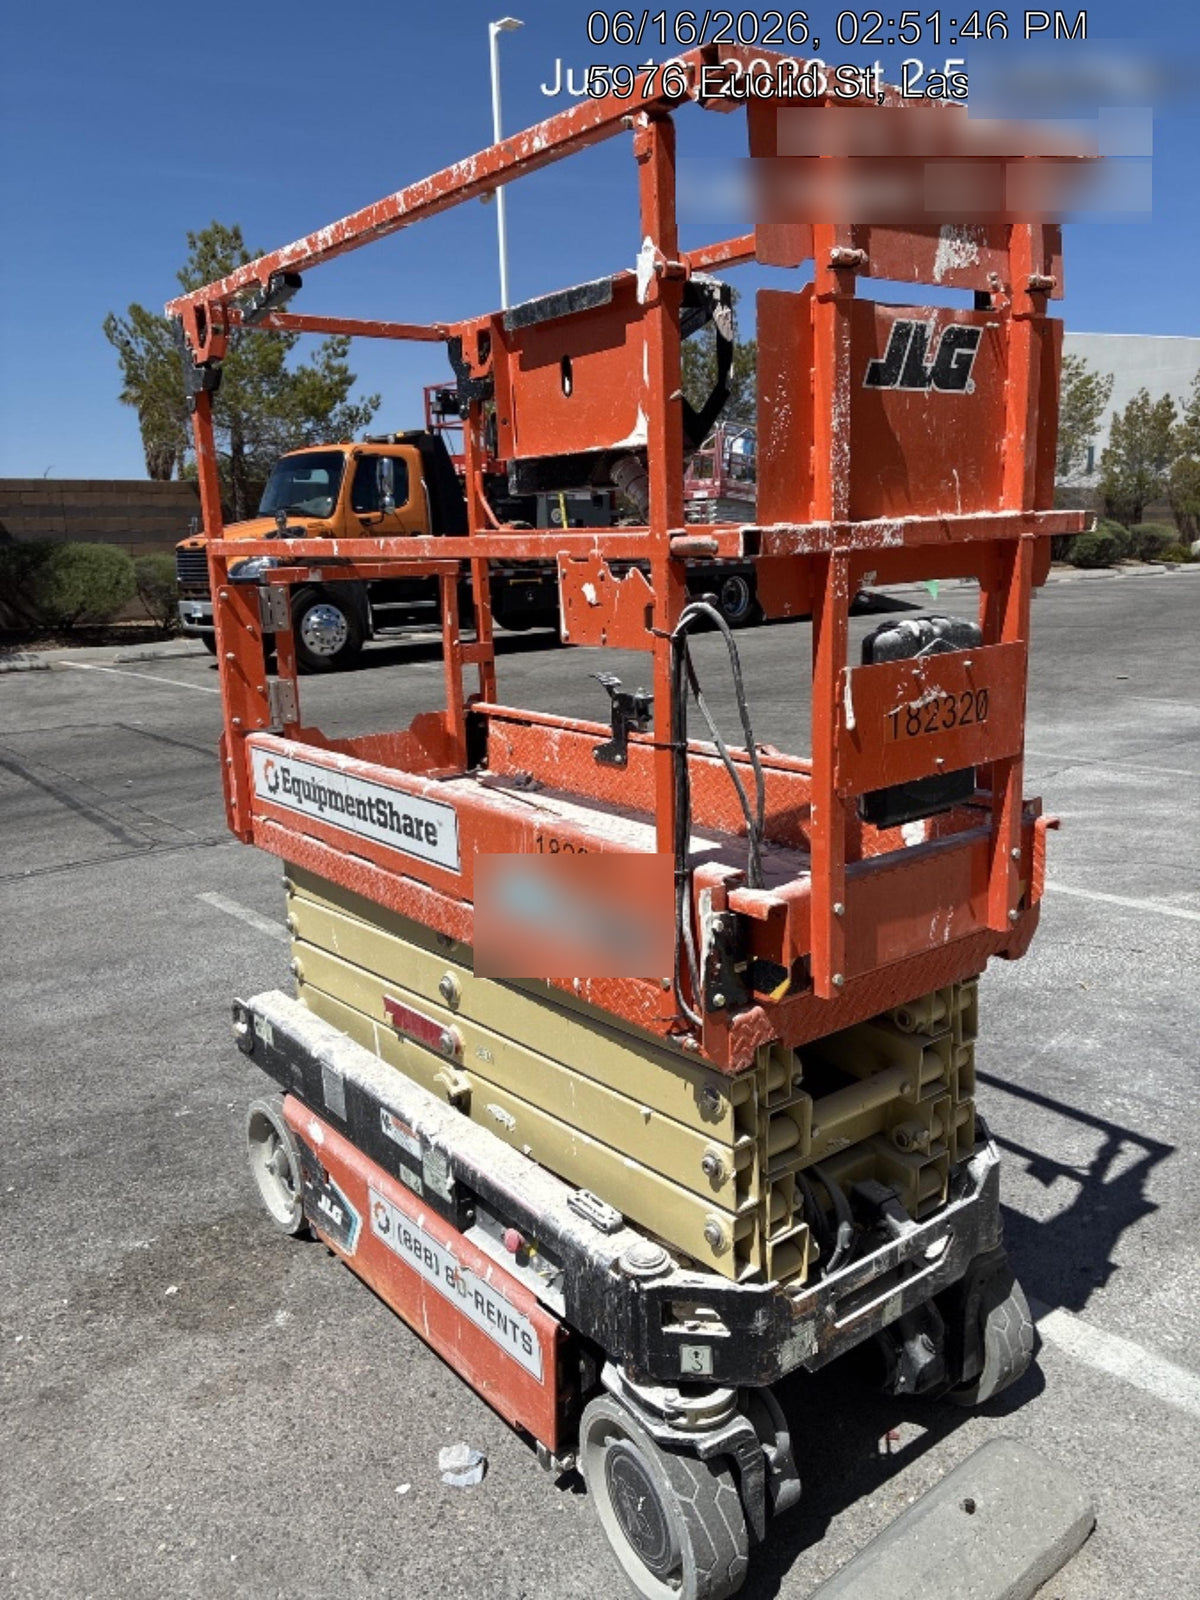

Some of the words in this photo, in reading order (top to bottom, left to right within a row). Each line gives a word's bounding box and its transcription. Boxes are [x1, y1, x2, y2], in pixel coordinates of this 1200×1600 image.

[862, 318, 984, 394] JLG
[887, 689, 989, 740] 182320
[279, 766, 440, 848] EquipmentShare
[317, 1194, 344, 1226] JLG
[398, 1223, 440, 1277] (888)
